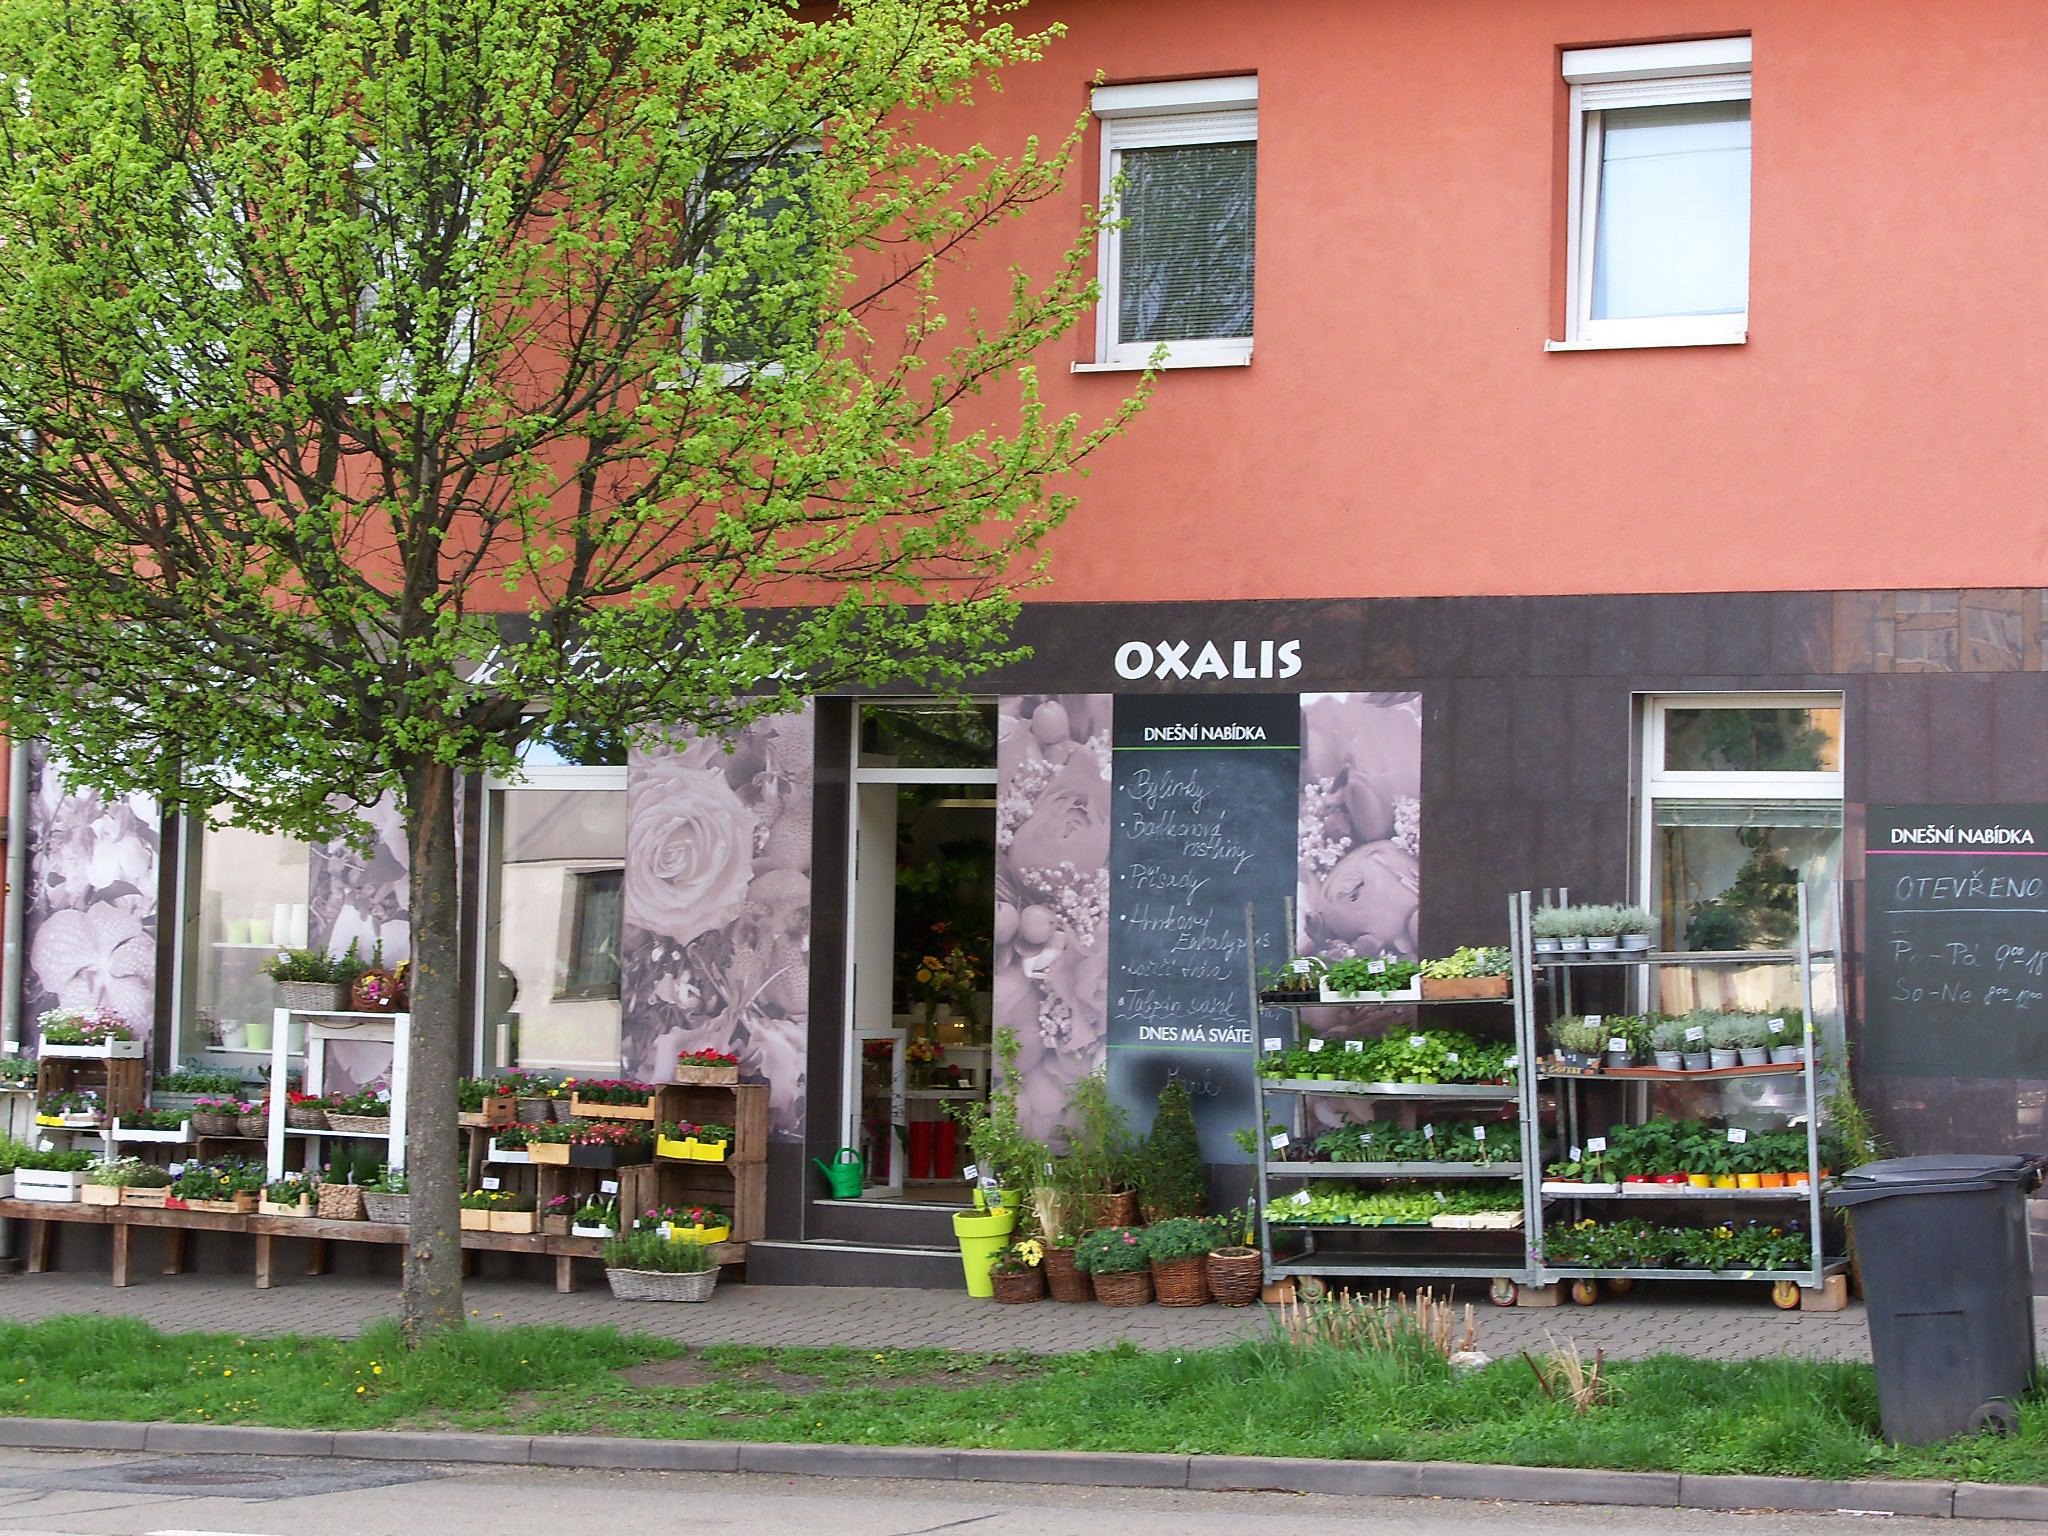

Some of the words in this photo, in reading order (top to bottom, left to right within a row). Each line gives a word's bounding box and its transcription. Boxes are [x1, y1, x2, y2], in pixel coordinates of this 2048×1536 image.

[1114, 640, 1302, 680] OXALIS
[1144, 722, 1199, 741] DNEŠNÍ
[1201, 722, 1267, 740] NABÍDKA
[1127, 769, 1218, 814] Bylinky
[1890, 825, 1955, 844] DNEŠNÍ
[1957, 825, 2035, 844] NABÍDKA
[1896, 867, 2042, 899] OTEVŘENO
[1139, 1026, 1178, 1040] DNES
[1180, 1024, 1207, 1041] MÁ
[1208, 1025, 1252, 1043] SVÁTE
